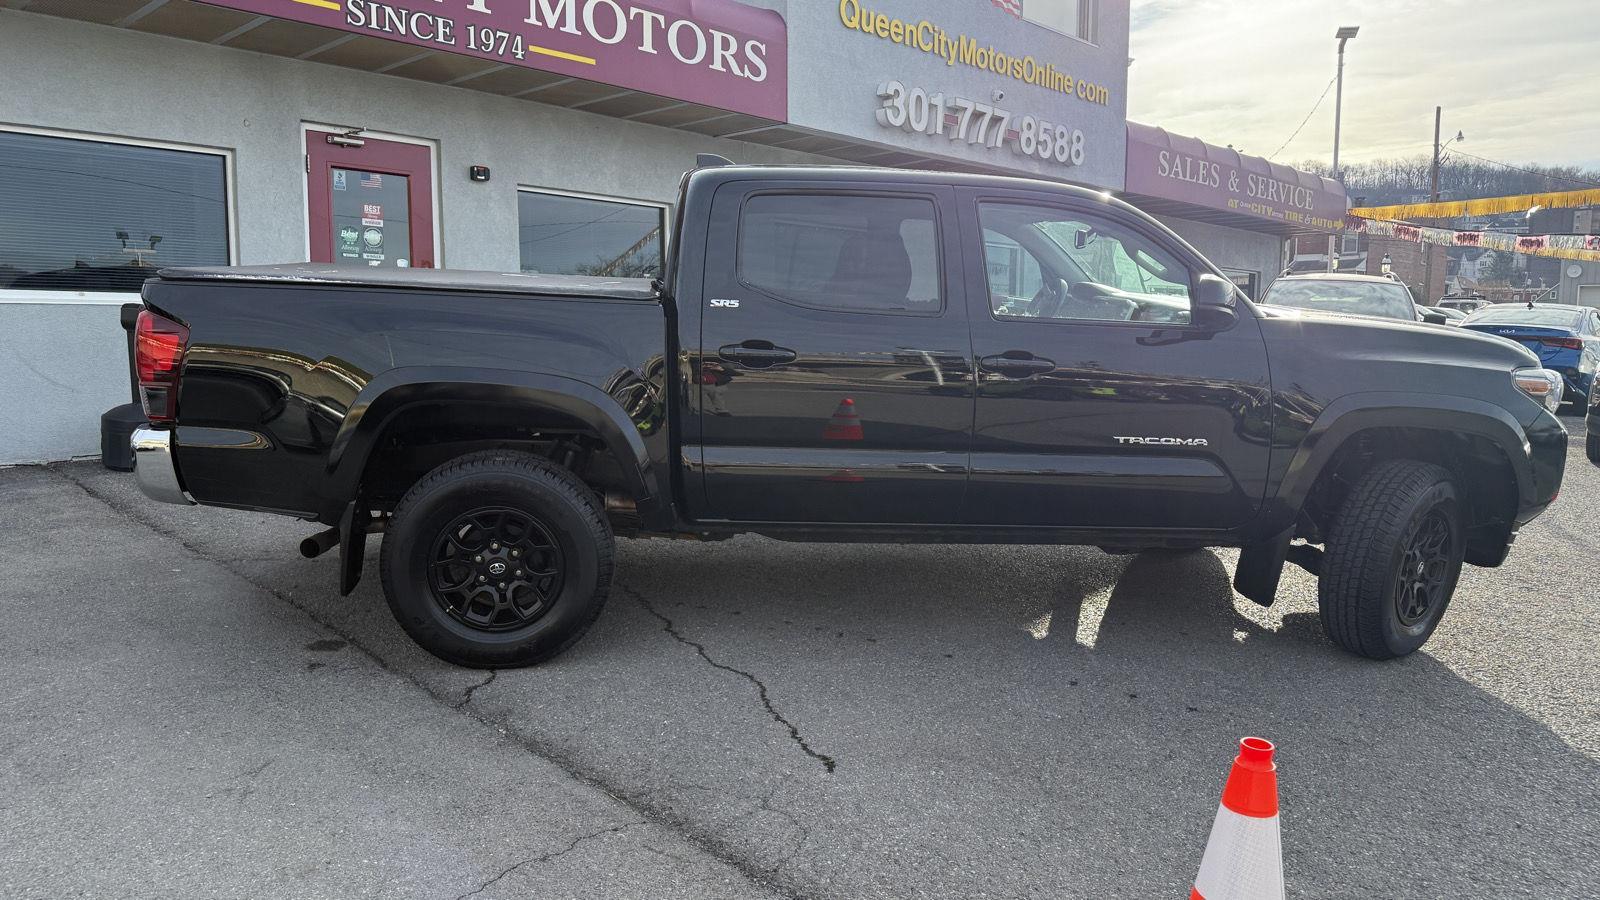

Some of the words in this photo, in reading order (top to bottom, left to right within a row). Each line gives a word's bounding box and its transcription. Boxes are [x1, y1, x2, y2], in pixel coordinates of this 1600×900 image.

[347, 0, 456, 45] SINCE
[466, 25, 526, 60] 1974
[524, 0, 767, 82] MOTORS
[1158, 150, 1220, 188] SALES
[1228, 169, 1240, 192] &
[1247, 173, 1314, 210] SERVICE
[363, 204, 381, 213] BEST
[1251, 203, 1273, 216] CITY
[1284, 210, 1304, 223] TIRE
[1311, 216, 1333, 229] AUTO
[710, 299, 740, 308] SR5
[1112, 436, 1208, 446] TACOMA
